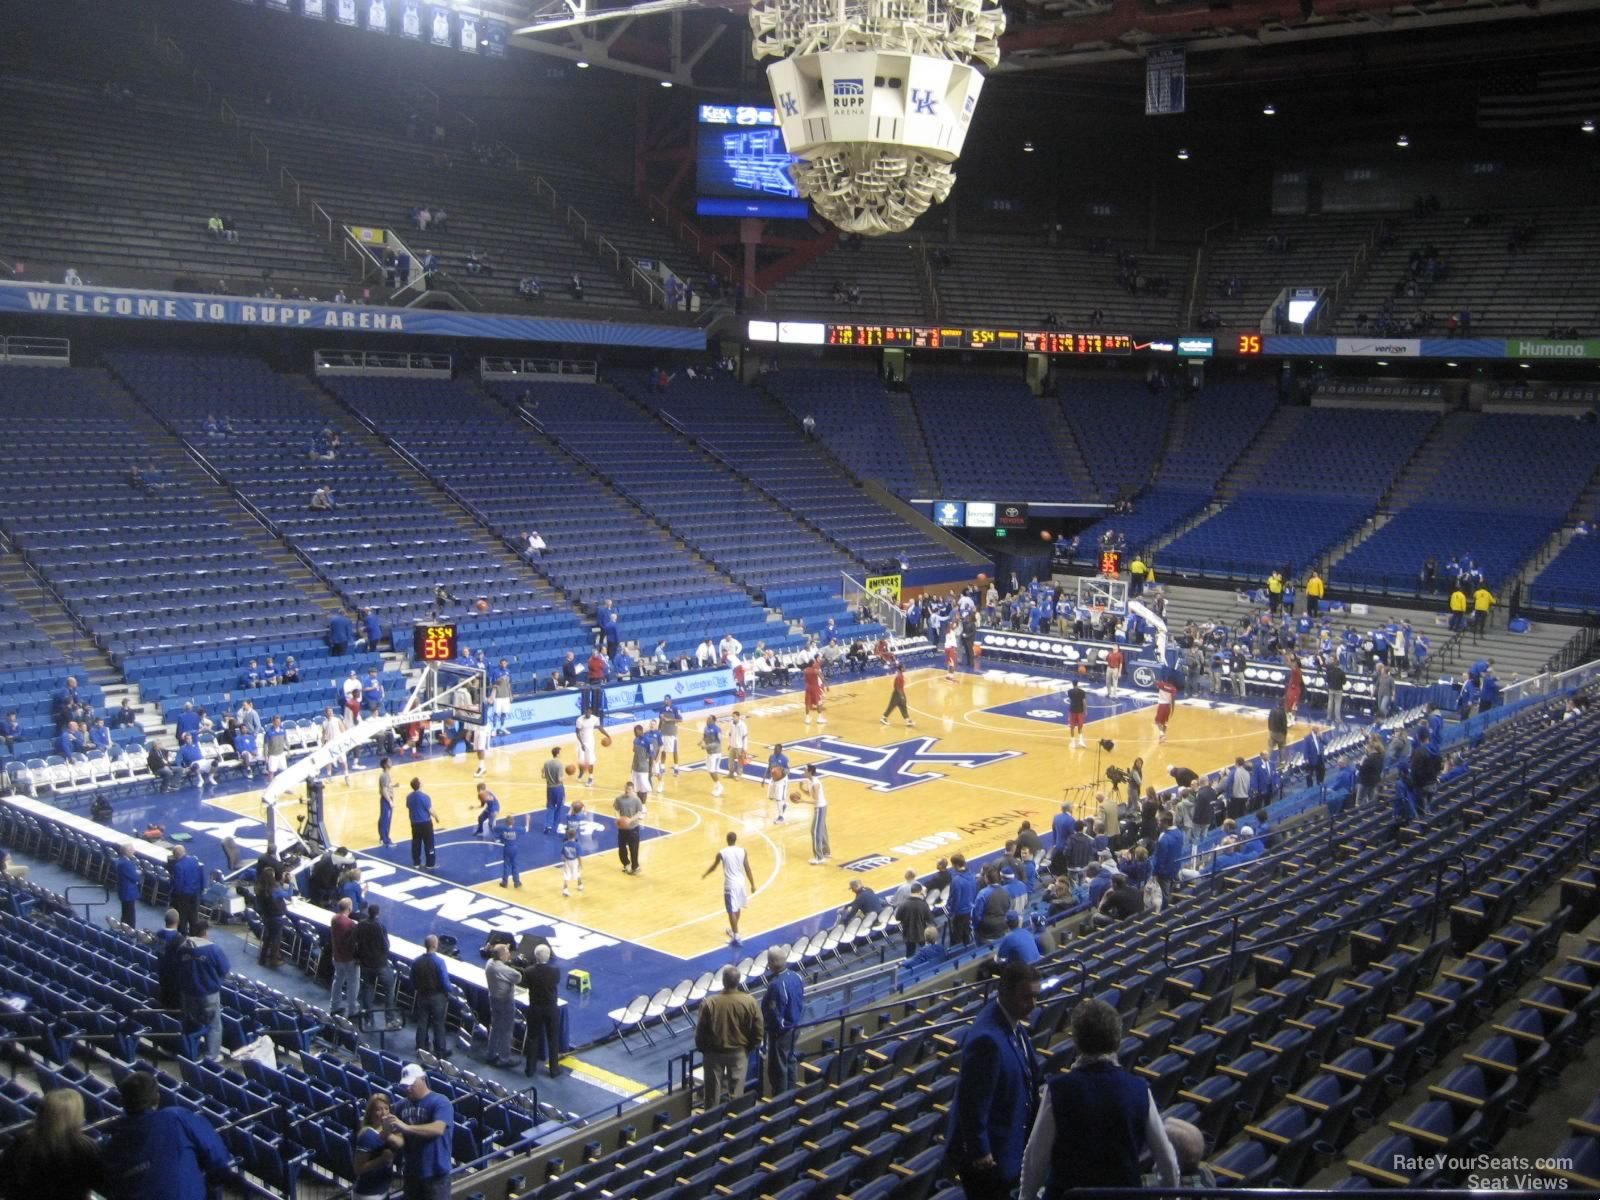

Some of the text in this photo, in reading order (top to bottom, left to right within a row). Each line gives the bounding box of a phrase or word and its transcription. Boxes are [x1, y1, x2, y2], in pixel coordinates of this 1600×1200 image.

[833, 98, 865, 108] RUPP
[28, 291, 404, 330] WELCOME TO RUPP ARENA
[1239, 336, 1259, 353] 35
[1374, 343, 1407, 354] verizon
[1519, 341, 1585, 356] Humana
[427, 627, 453, 639] 5:54
[425, 639, 449, 659] 35
[957, 808, 1040, 836] ARENA
